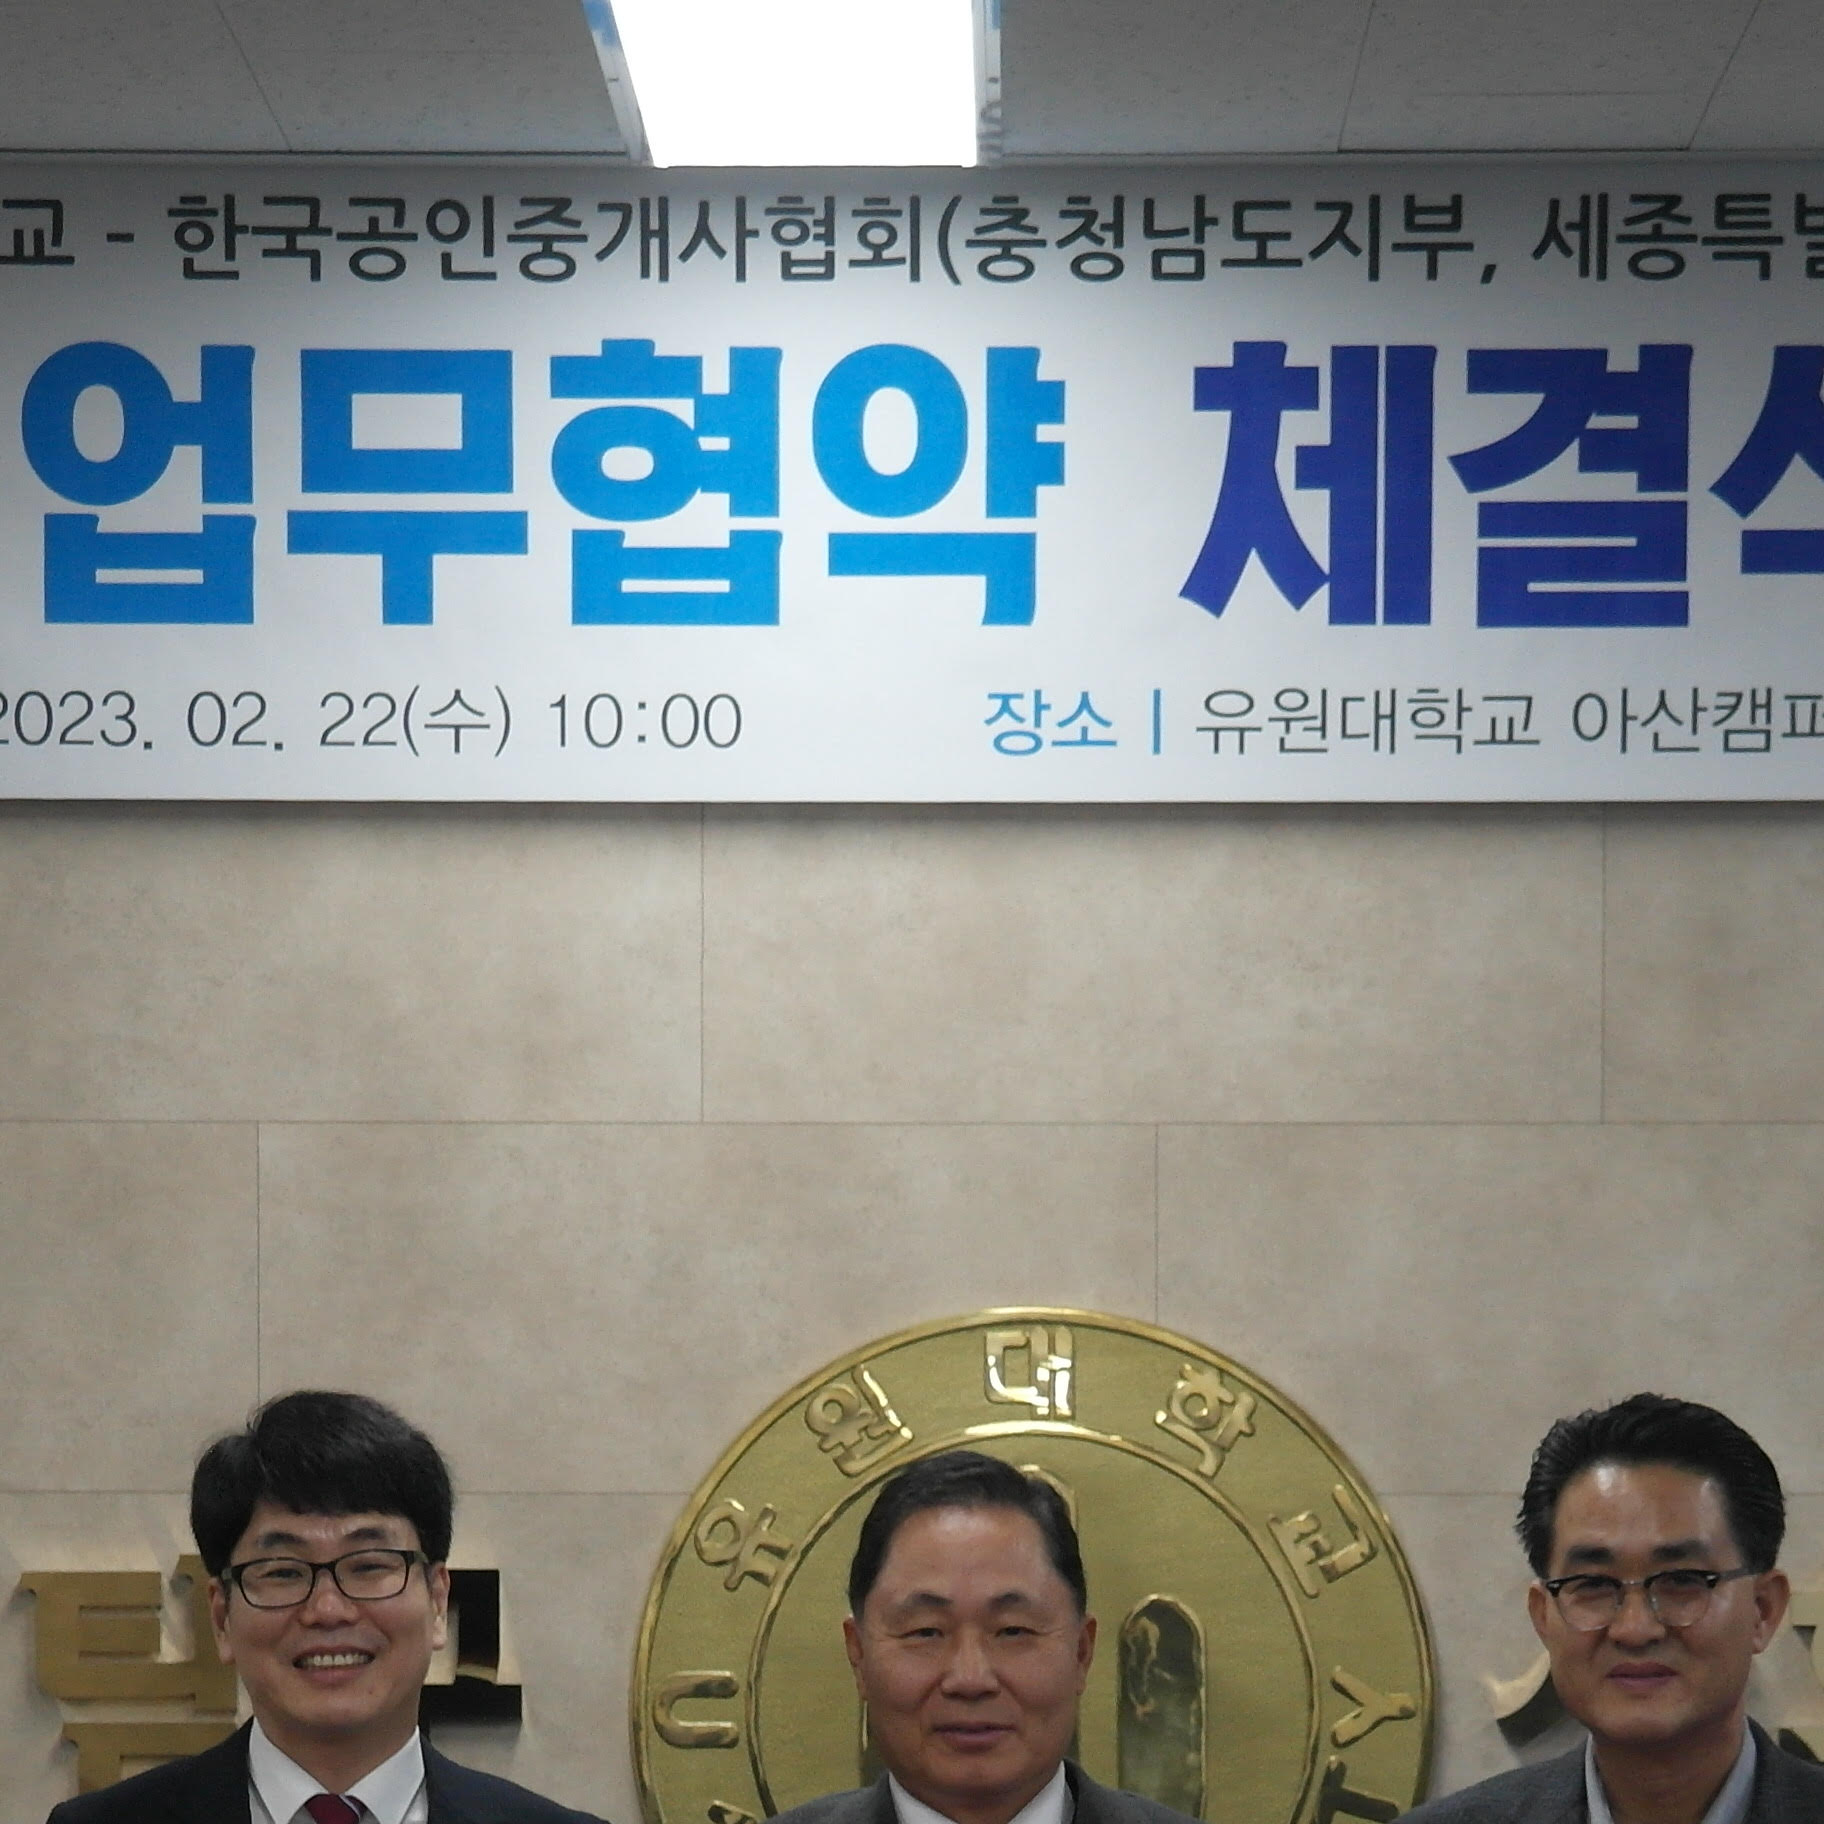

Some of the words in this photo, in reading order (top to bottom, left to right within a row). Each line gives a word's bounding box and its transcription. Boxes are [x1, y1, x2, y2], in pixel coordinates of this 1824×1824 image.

[166, 193, 1498, 287] 한국공인중개사협회(충청남도지부,
[20, 337, 1067, 627] 업무협약
[186, 690, 285, 752] 02.
[319, 684, 512, 759] 22(수)
[548, 692, 743, 750] 10:00
[982, 689, 1119, 758] 장소
[1195, 687, 1542, 756] 유원대학교
[694, 1326, 1380, 1600] 유원대학교
